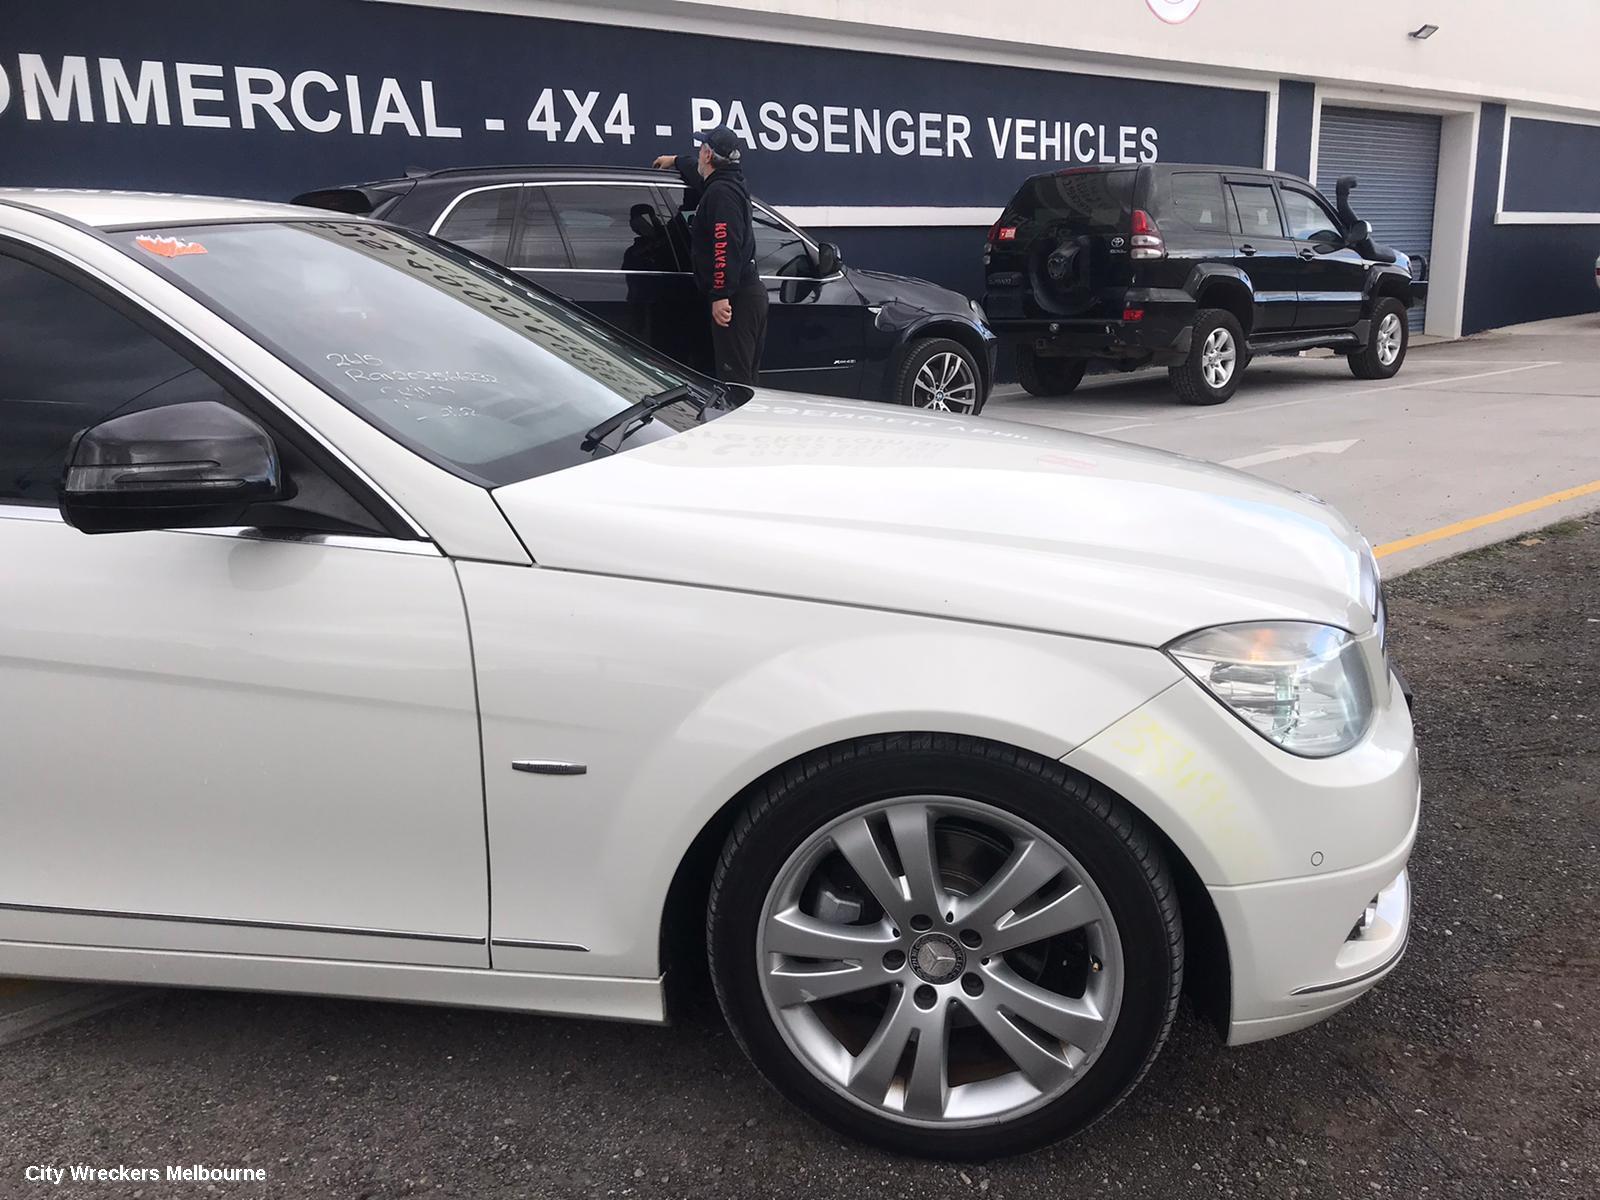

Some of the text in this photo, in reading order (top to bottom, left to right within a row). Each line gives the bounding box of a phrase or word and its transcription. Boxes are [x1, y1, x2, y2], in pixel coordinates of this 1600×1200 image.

[0, 53, 463, 139] MMERCIAL
[527, 87, 636, 145] 4X4
[691, 97, 974, 159] PASSENGER
[986, 117, 1160, 165] VEHICLES
[714, 241, 729, 269] DAYS
